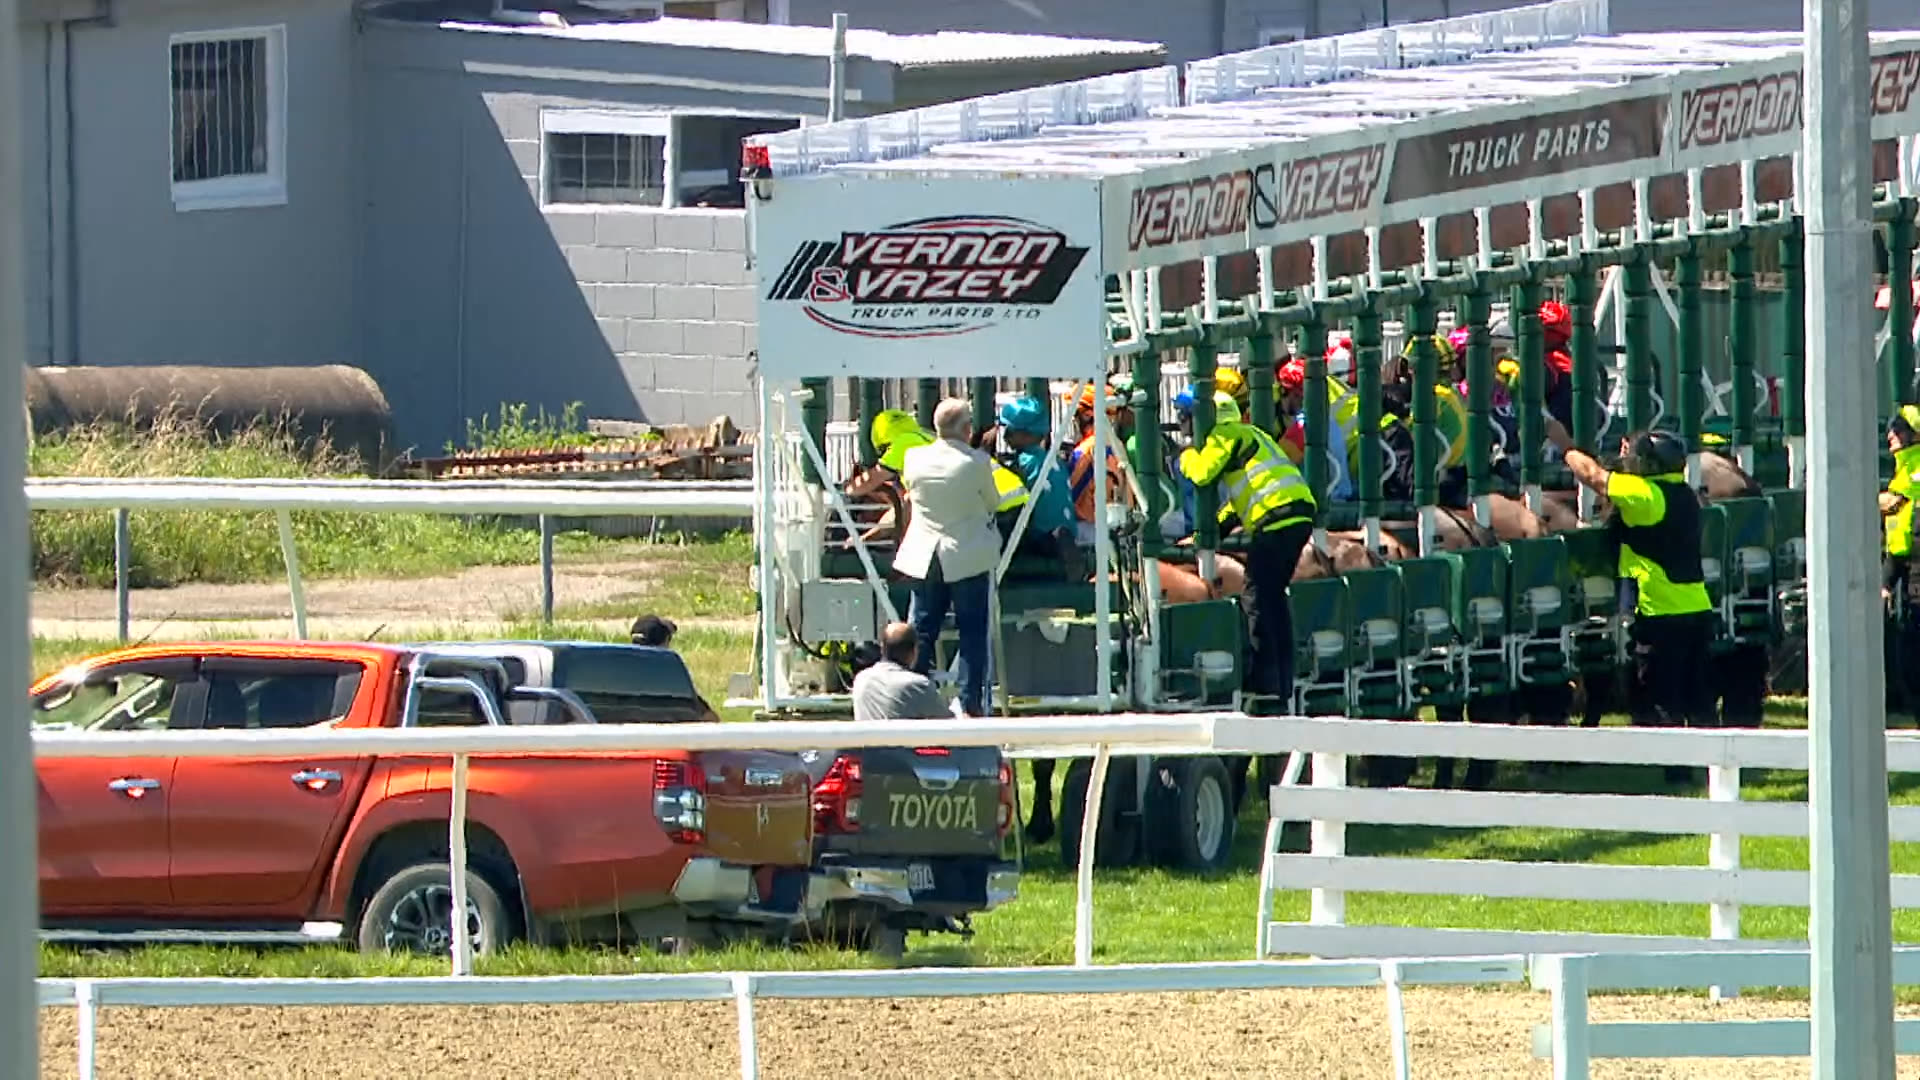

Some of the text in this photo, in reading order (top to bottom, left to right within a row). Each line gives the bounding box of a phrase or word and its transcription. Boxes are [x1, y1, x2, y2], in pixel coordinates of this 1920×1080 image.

[1680, 72, 1799, 150] VERNON
[1448, 119, 1612, 178] TRUCK PARTS
[1128, 144, 1386, 251] VERNON & VAZEY
[842, 234, 1062, 266] VERNON
[811, 267, 1042, 302] & VAZEY
[851, 306, 1042, 320] TRUCK PARTS LTD
[889, 794, 978, 830] TOYOTA
